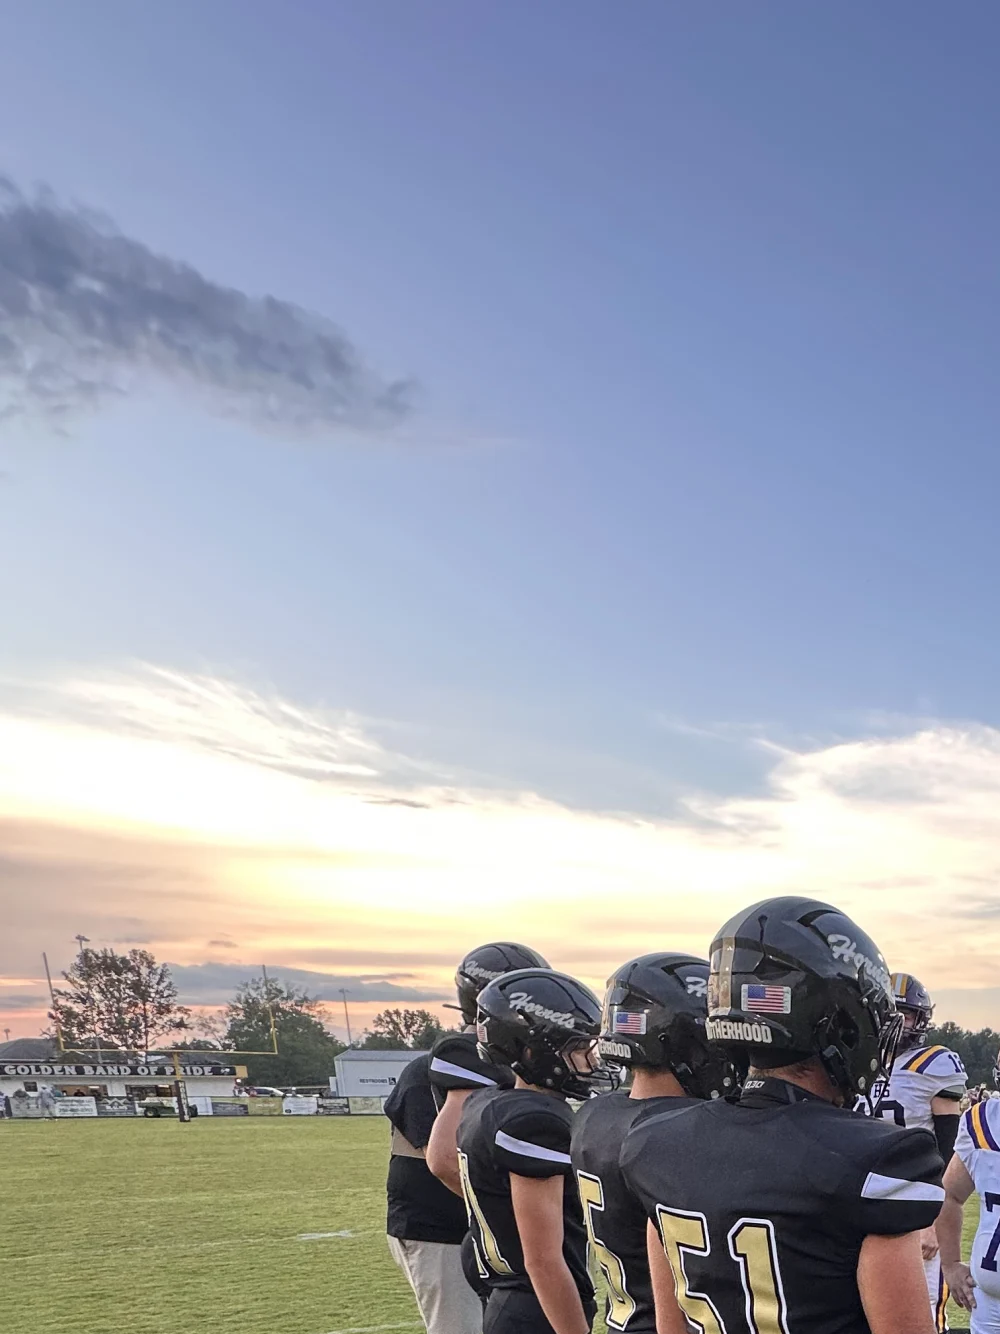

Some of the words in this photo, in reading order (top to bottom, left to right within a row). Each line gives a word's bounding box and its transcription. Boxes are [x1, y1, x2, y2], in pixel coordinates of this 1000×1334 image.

[509, 992, 575, 1029] Hornets
[4, 1065, 77, 1075] GOLDEN
[83, 1065, 131, 1075] BAND
[137, 1066, 158, 1075] OF
[164, 1066, 213, 1076] PRIDE
